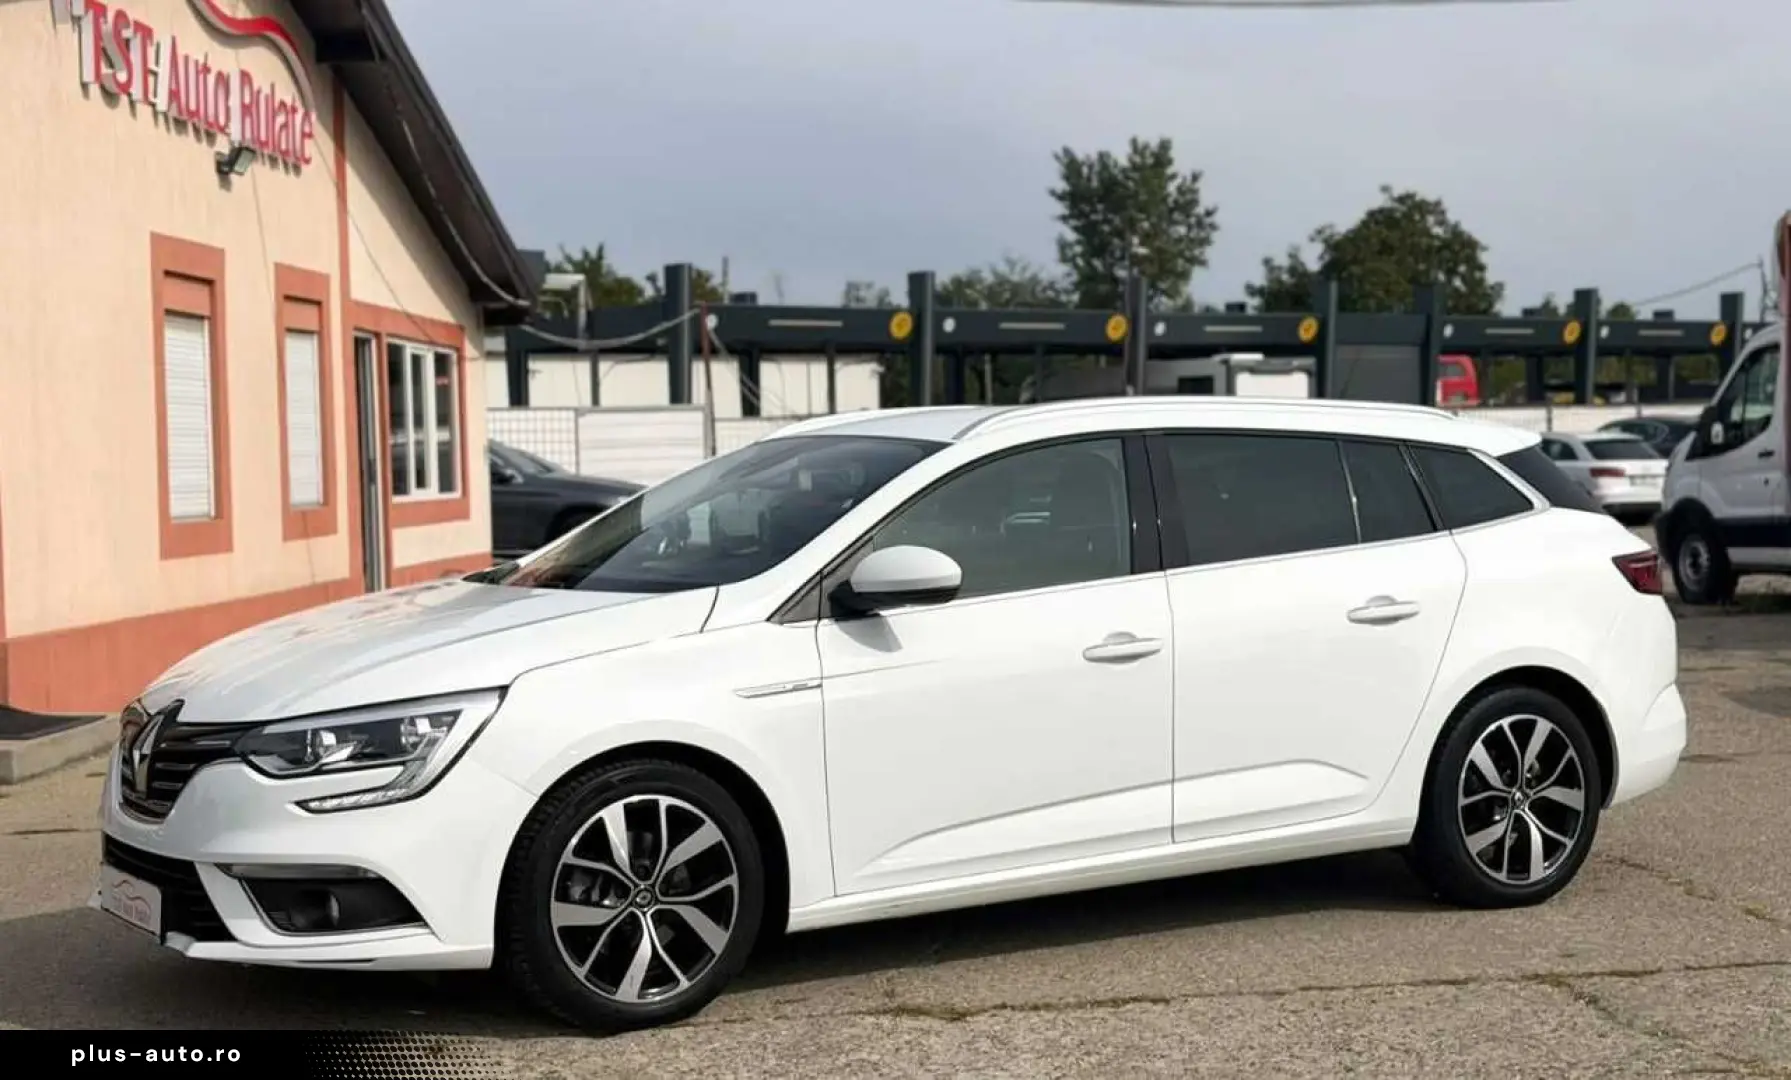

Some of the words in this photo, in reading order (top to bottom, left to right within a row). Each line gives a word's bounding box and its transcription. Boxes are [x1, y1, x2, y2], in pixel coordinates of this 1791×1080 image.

[80, 0, 154, 106] TST
[165, 35, 232, 137] Auto
[237, 68, 316, 167] Rulate
